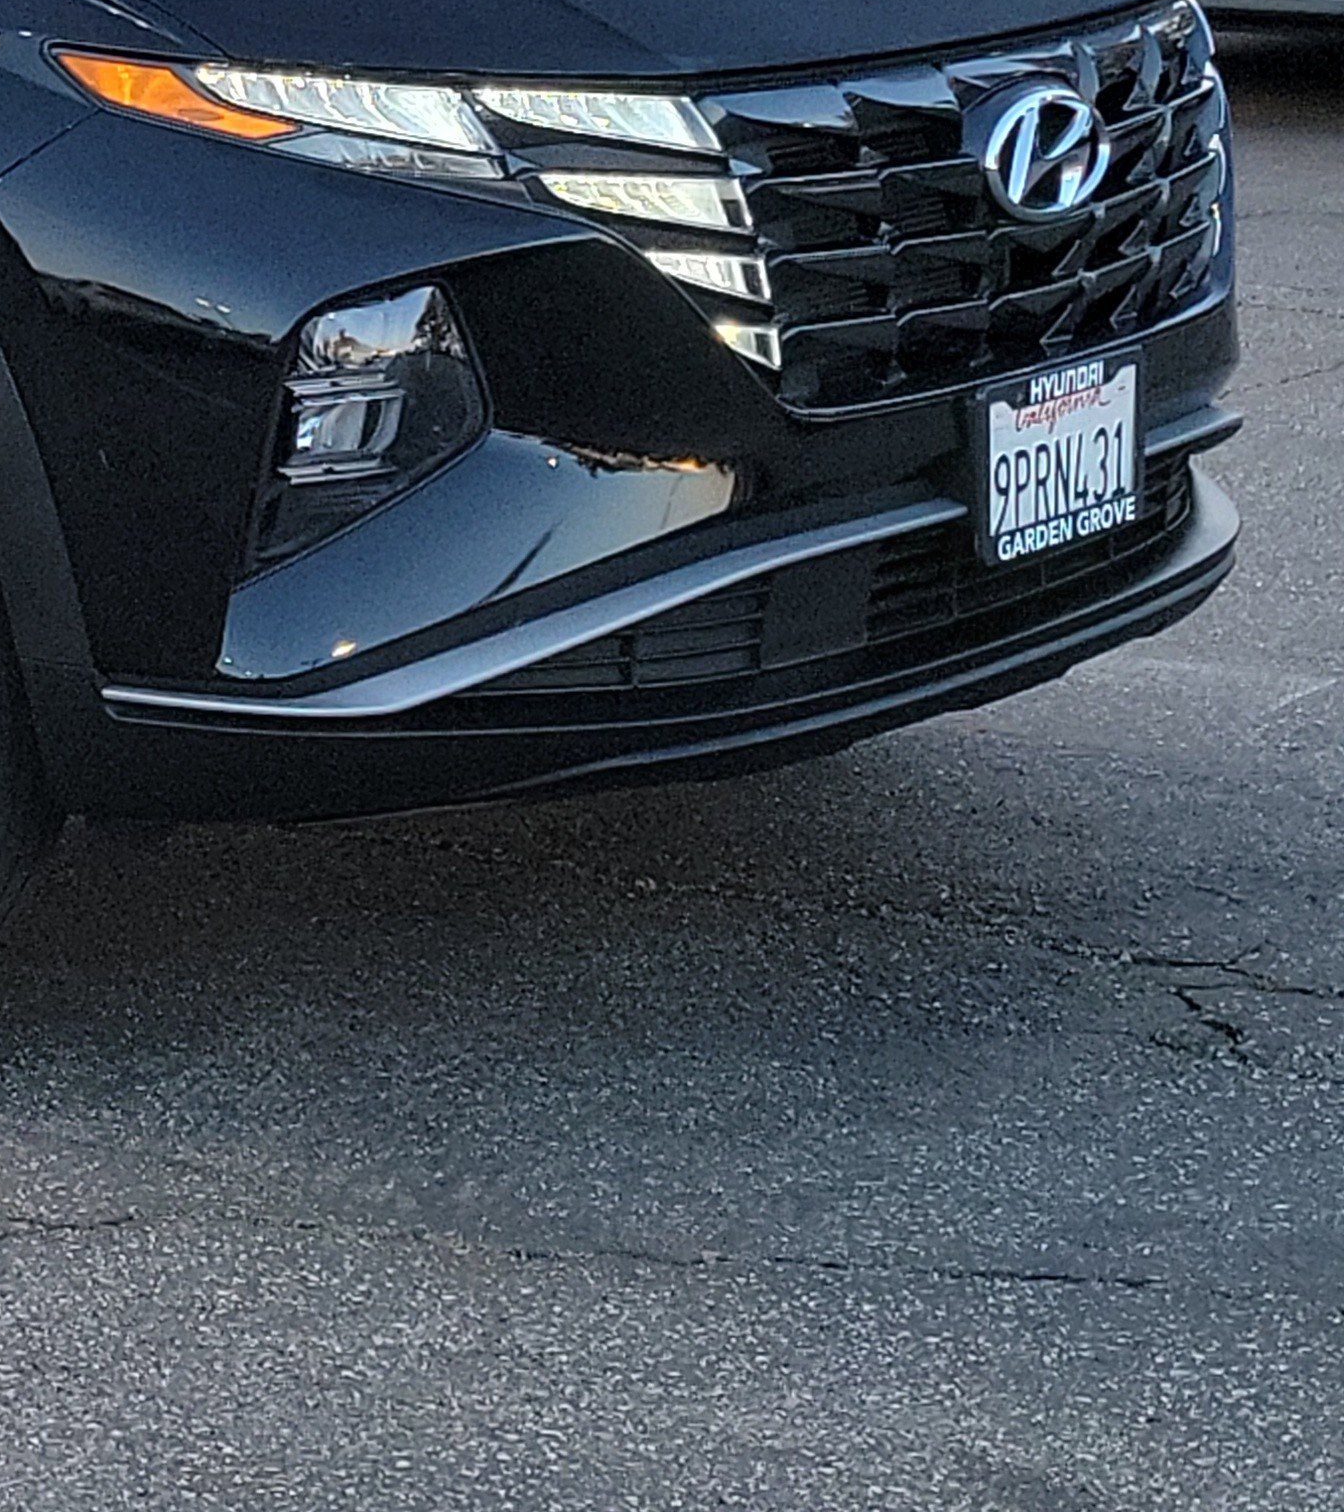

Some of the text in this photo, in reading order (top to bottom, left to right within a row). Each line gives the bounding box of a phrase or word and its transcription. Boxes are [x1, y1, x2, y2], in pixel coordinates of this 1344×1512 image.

[1030, 361, 1104, 404] HYUNDAI
[993, 421, 1125, 536] 9PRN431
[998, 495, 1136, 561] GARDEN GROVE
